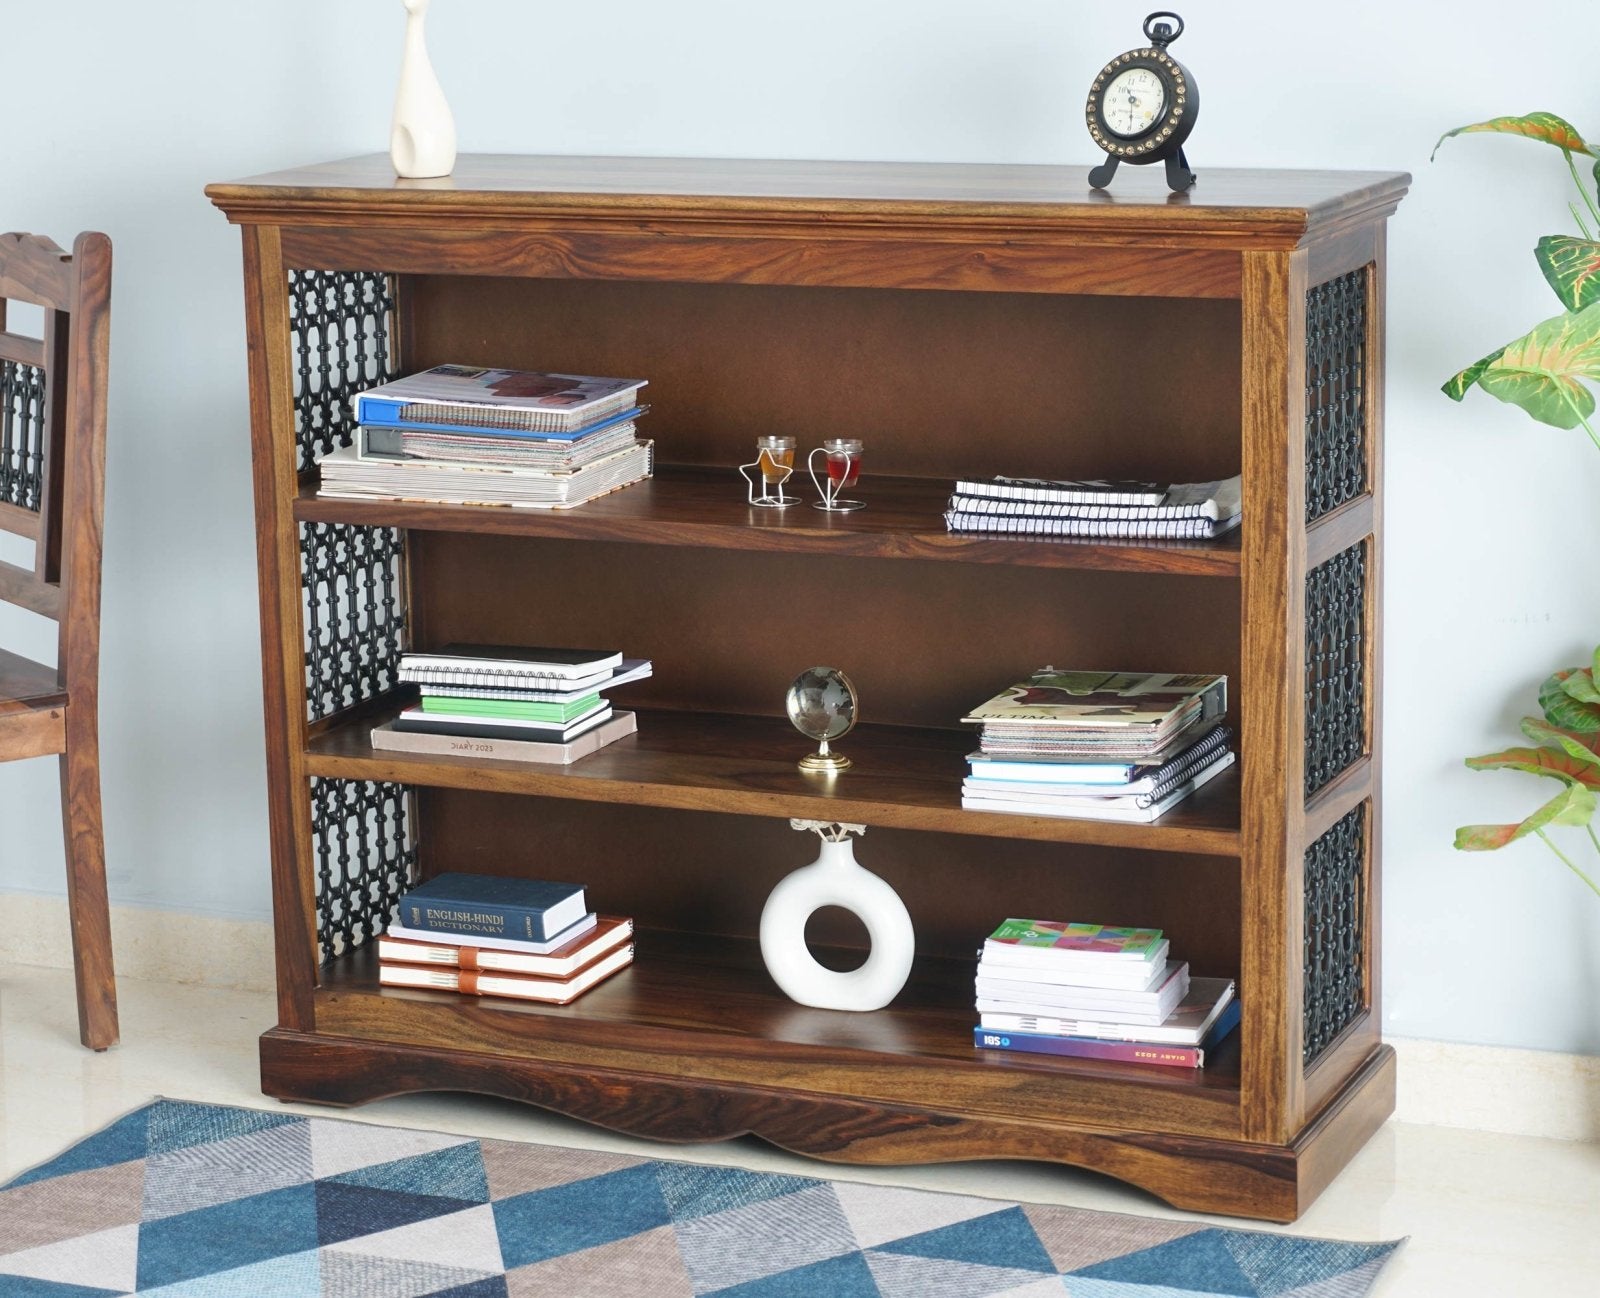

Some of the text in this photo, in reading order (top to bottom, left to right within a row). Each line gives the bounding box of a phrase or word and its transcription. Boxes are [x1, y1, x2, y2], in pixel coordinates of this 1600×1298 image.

[1128, 78, 1136, 86] 11
[1139, 75, 1147, 83] 12
[1118, 86, 1126, 94] 10
[450, 740, 494, 752] DIARY 2023
[427, 909, 504, 925] ENGLISH-HINDI
[429, 920, 504, 934] DICTIONARY
[984, 1035, 1001, 1046] SBI
[1135, 1051, 1158, 1059] 2023
